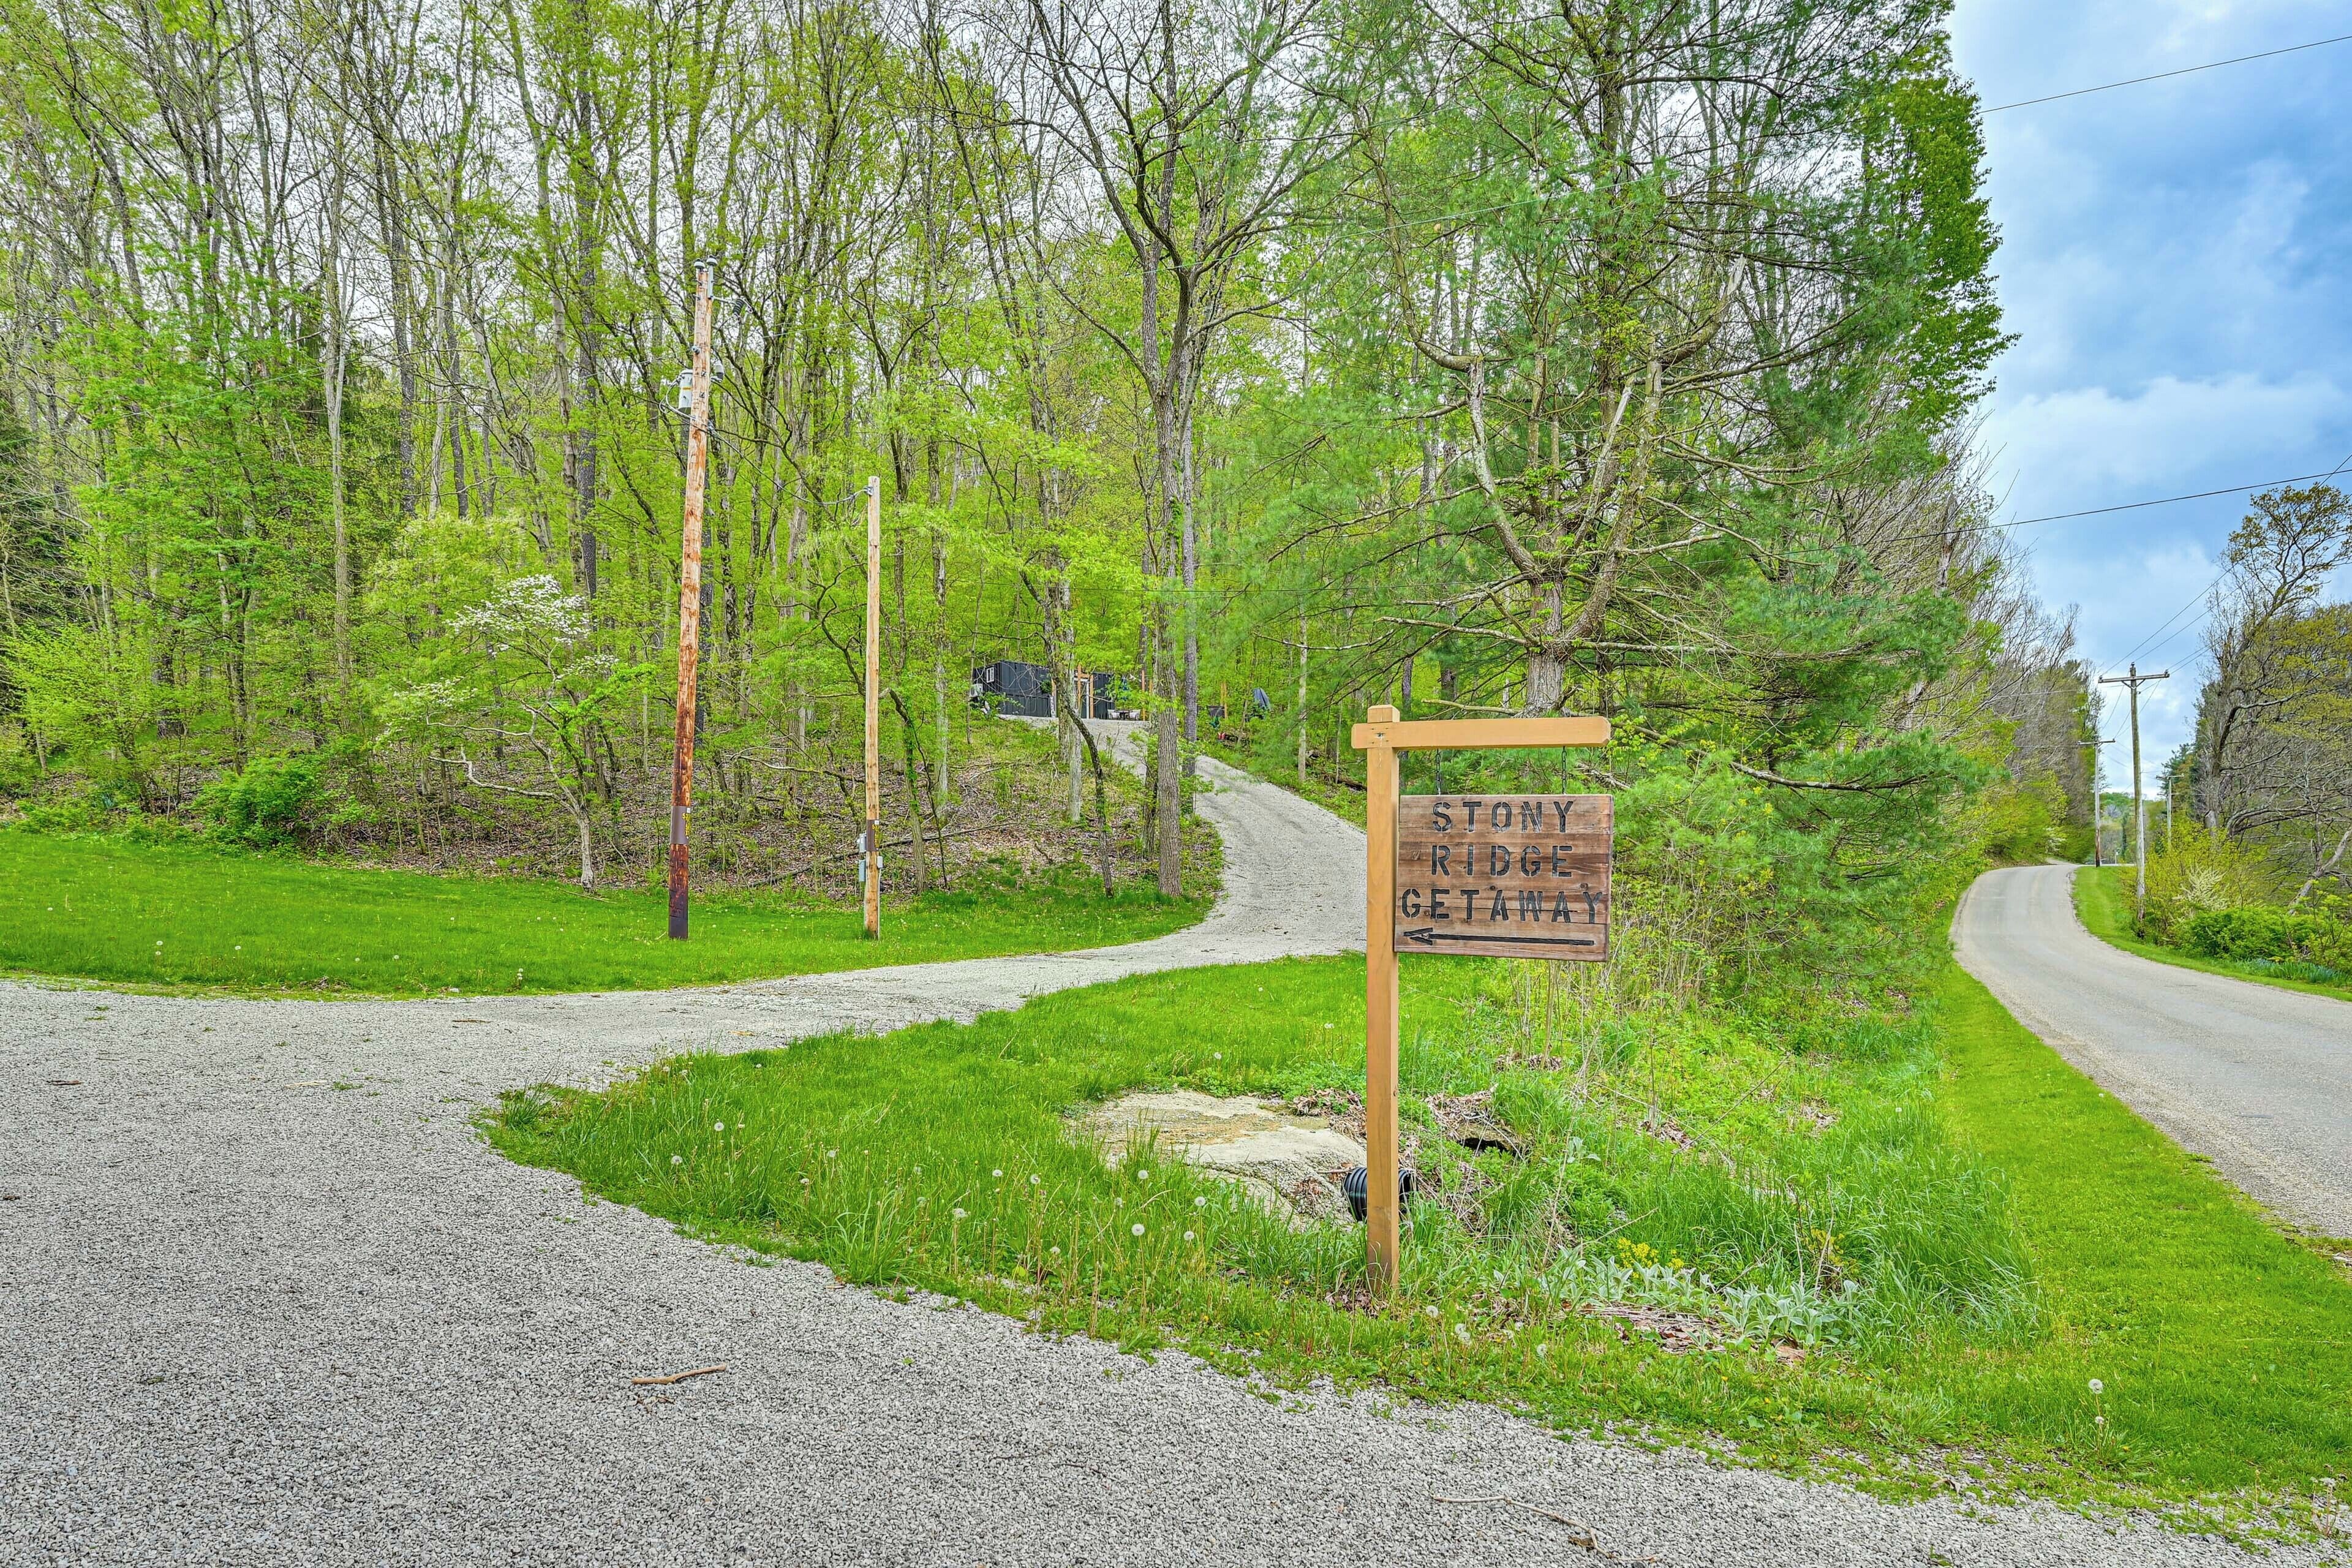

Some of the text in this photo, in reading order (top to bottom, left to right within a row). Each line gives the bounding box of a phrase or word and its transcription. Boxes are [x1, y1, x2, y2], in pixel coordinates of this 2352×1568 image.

[1432, 801, 1574, 833] STONY
[1431, 845, 1572, 877] RIDGE
[1401, 888, 1602, 924] GETAWAY
